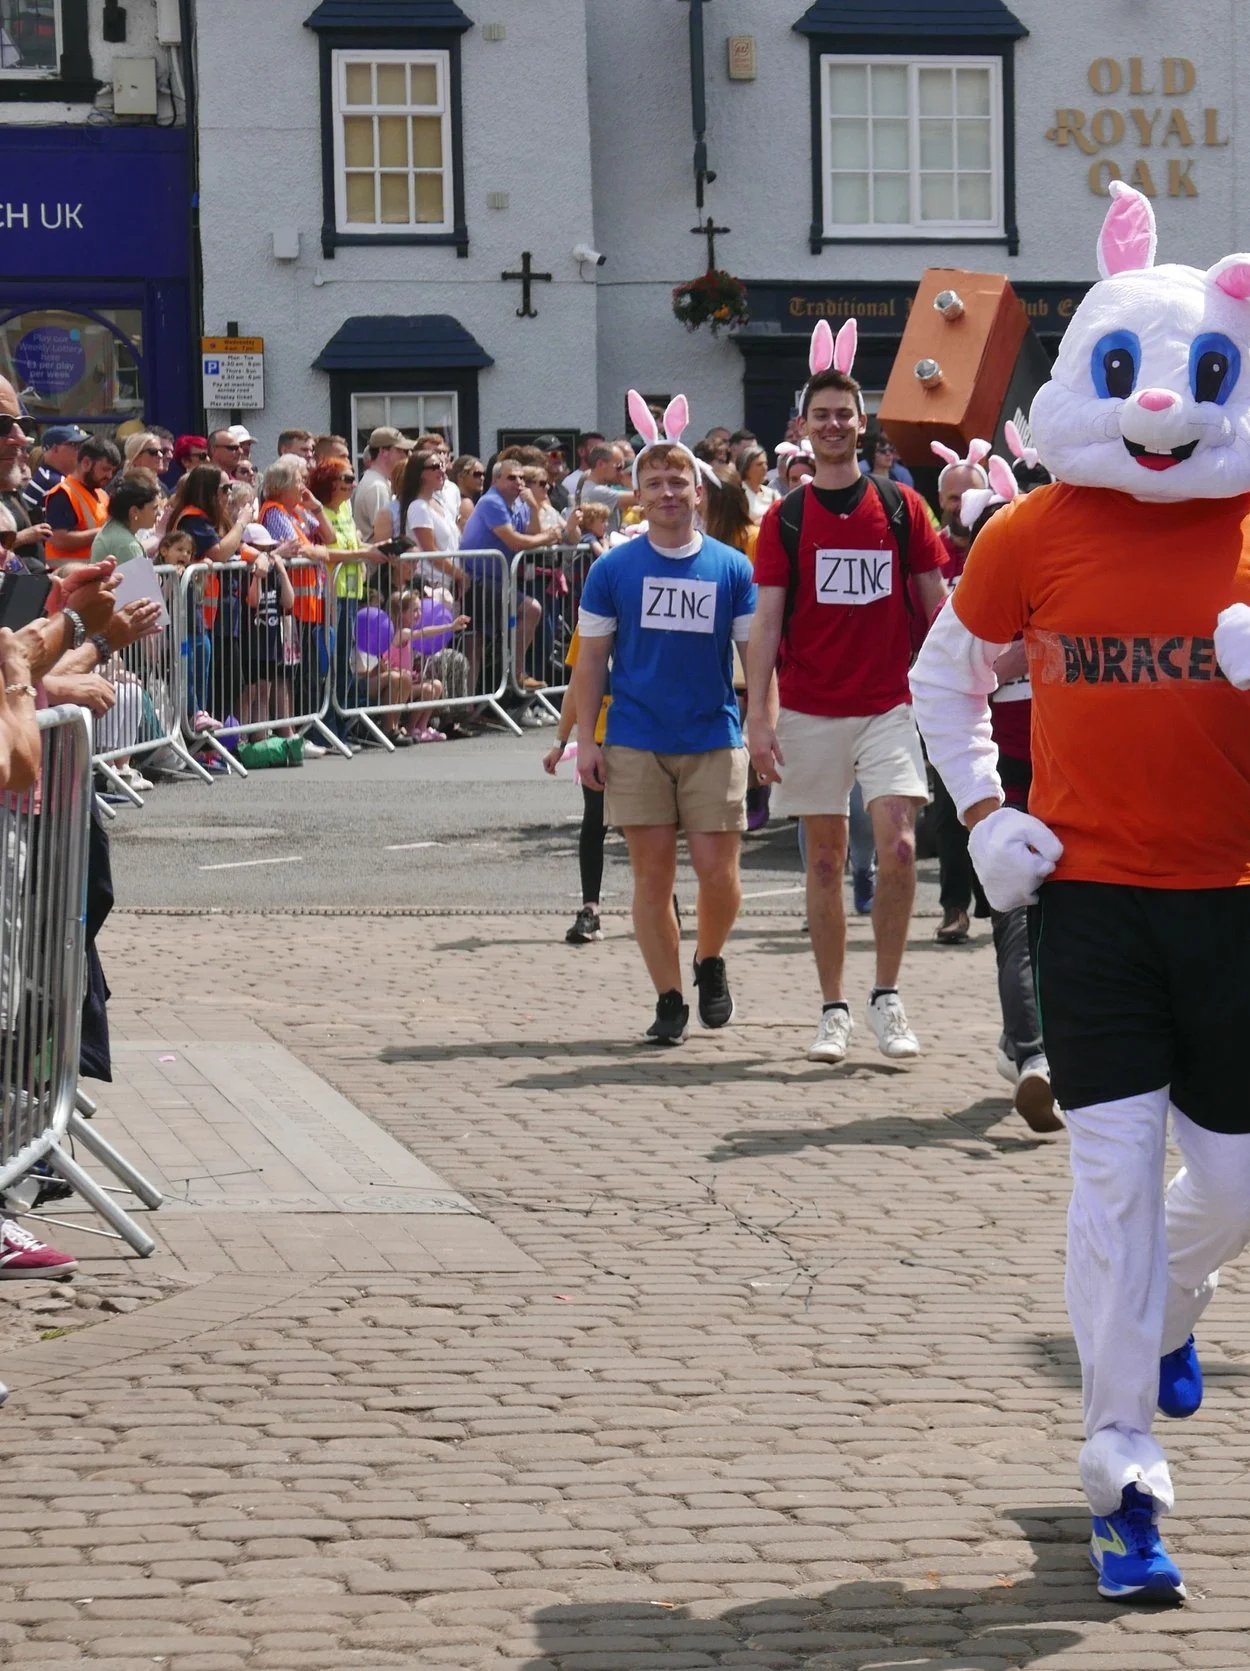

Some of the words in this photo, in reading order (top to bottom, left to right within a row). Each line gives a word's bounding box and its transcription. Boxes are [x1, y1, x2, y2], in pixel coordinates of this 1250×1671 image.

[1087, 56, 1197, 96] OLD
[1044, 107, 1231, 155] ROYAL
[1087, 158, 1200, 198] OAK
[40, 202, 84, 230] UK
[788, 295, 897, 317] Traditional
[820, 557, 892, 596] ZINC
[646, 586, 712, 620] ZINC
[1059, 634, 1227, 685] DURACE
